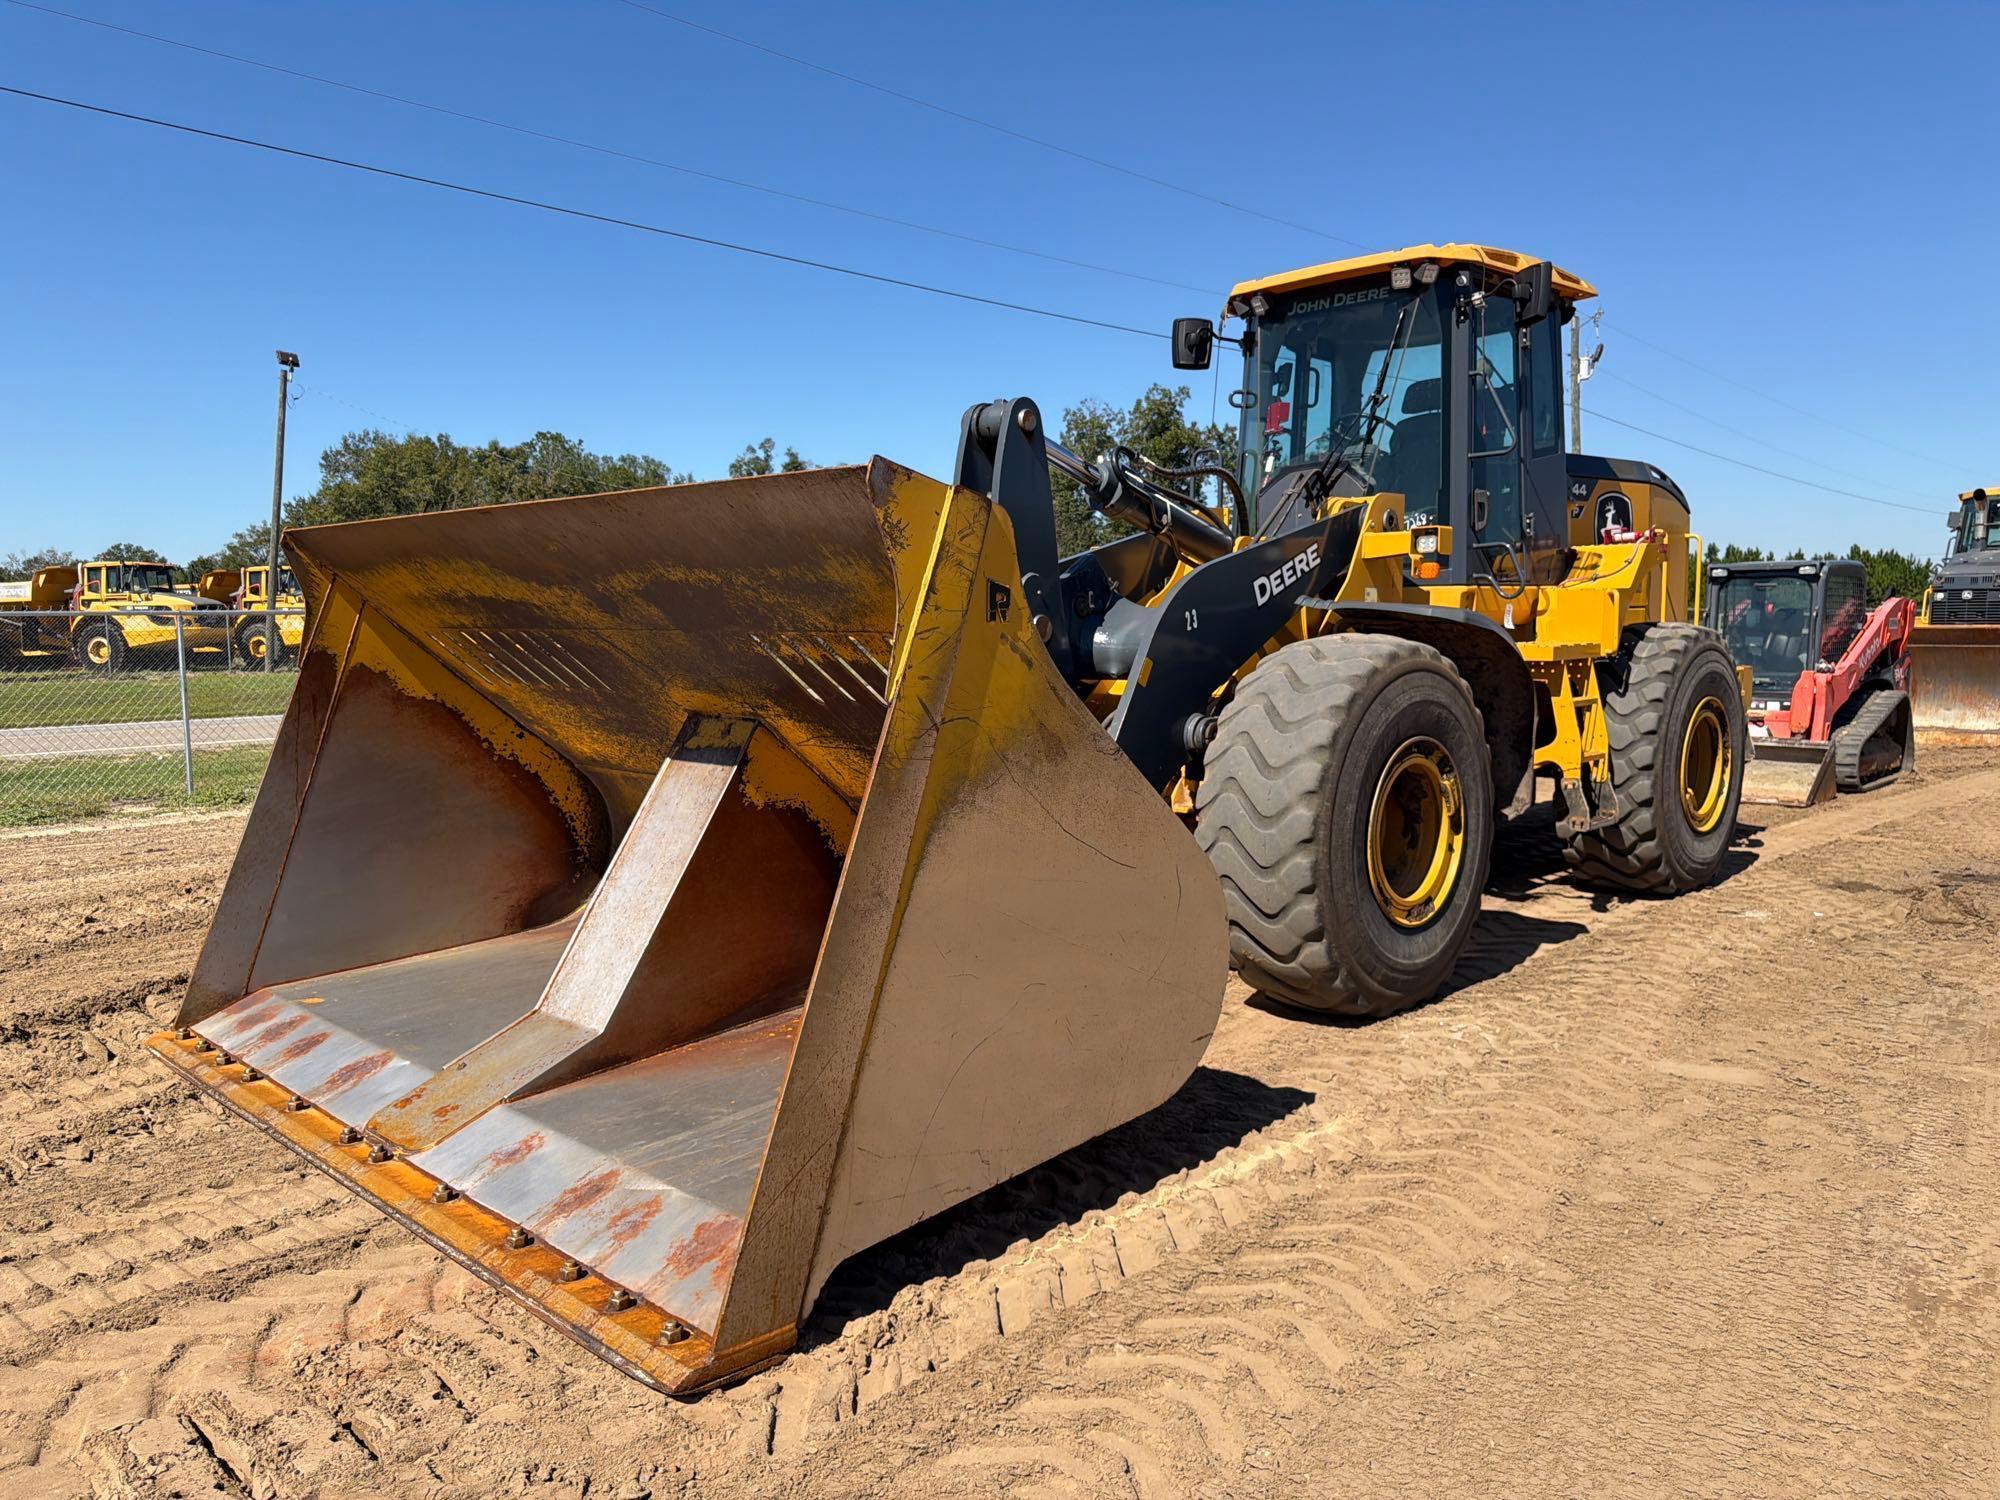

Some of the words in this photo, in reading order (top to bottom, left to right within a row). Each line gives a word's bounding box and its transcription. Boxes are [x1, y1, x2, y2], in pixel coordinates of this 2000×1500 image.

[1287, 299, 1330, 316] JOHN
[1333, 286, 1390, 307] DEERE
[1253, 543, 1321, 607] DEERE
